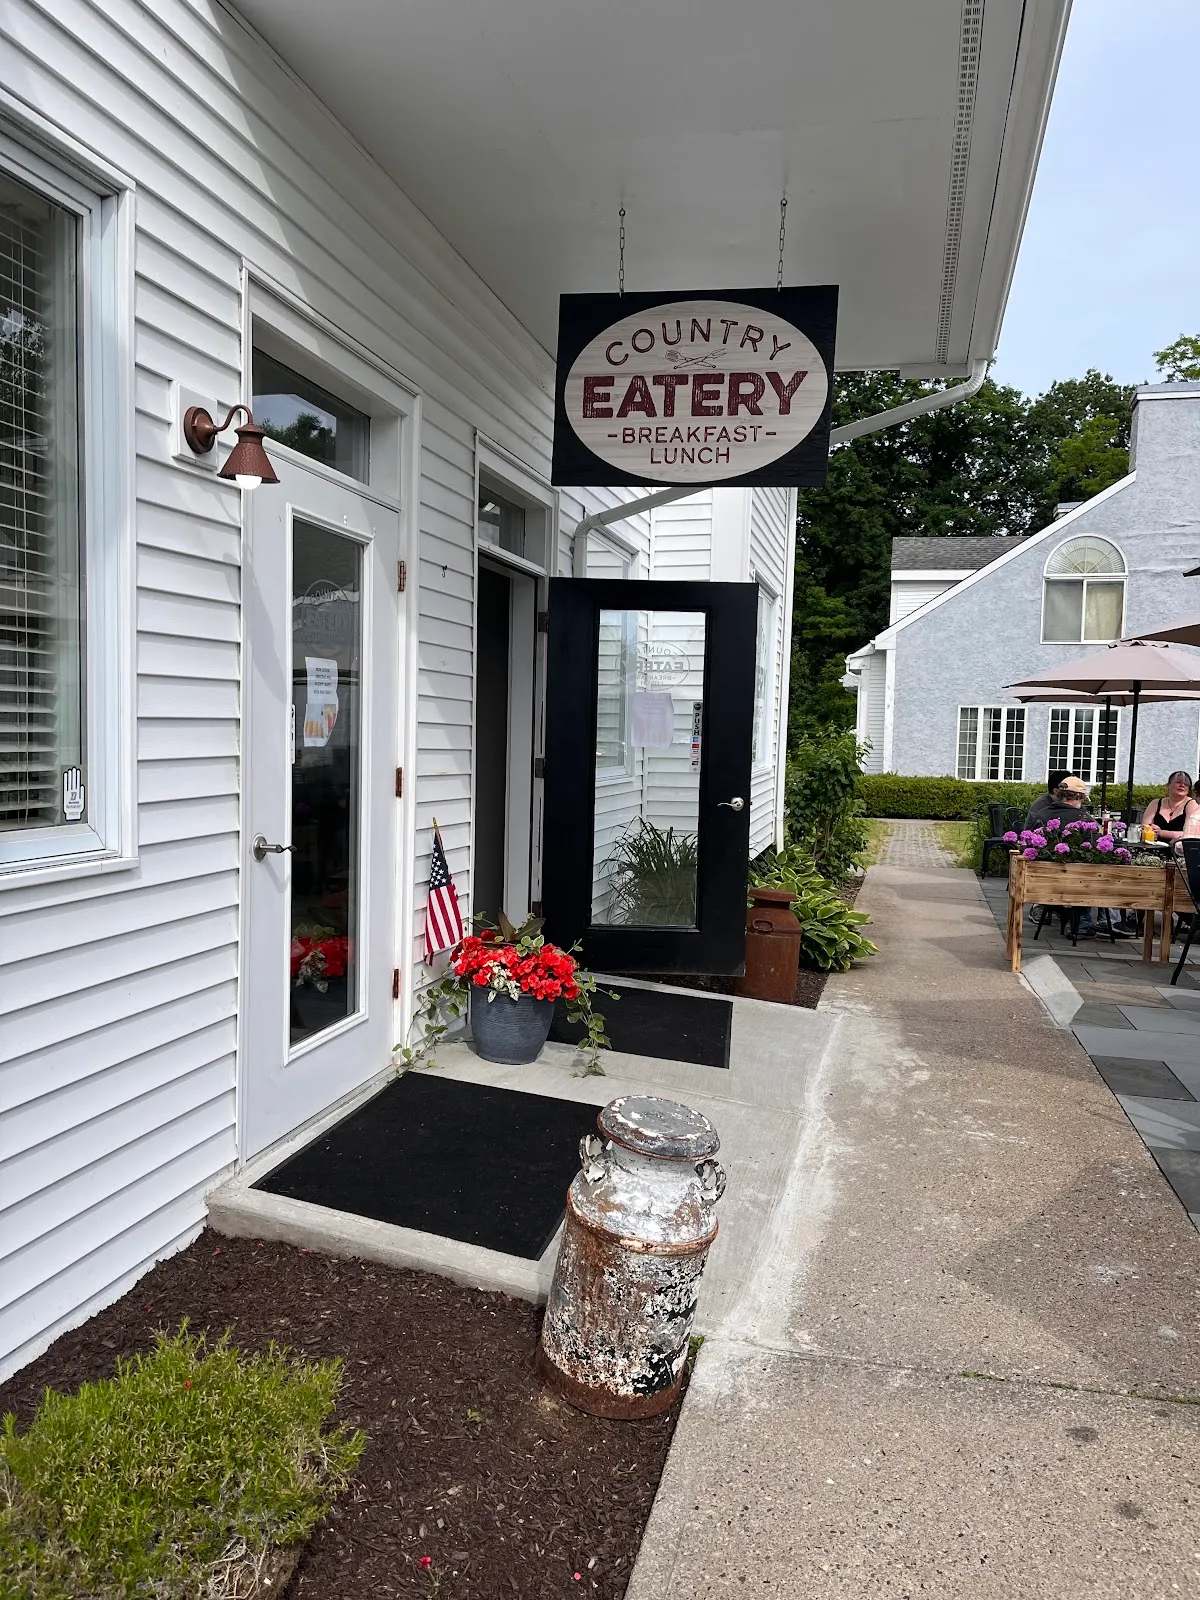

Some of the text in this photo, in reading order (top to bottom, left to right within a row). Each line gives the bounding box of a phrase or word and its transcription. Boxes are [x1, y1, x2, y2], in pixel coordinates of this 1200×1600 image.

[605, 318, 792, 366] COUNTRY
[582, 370, 809, 419] EATERY
[650, 447, 730, 464] LUNCH
